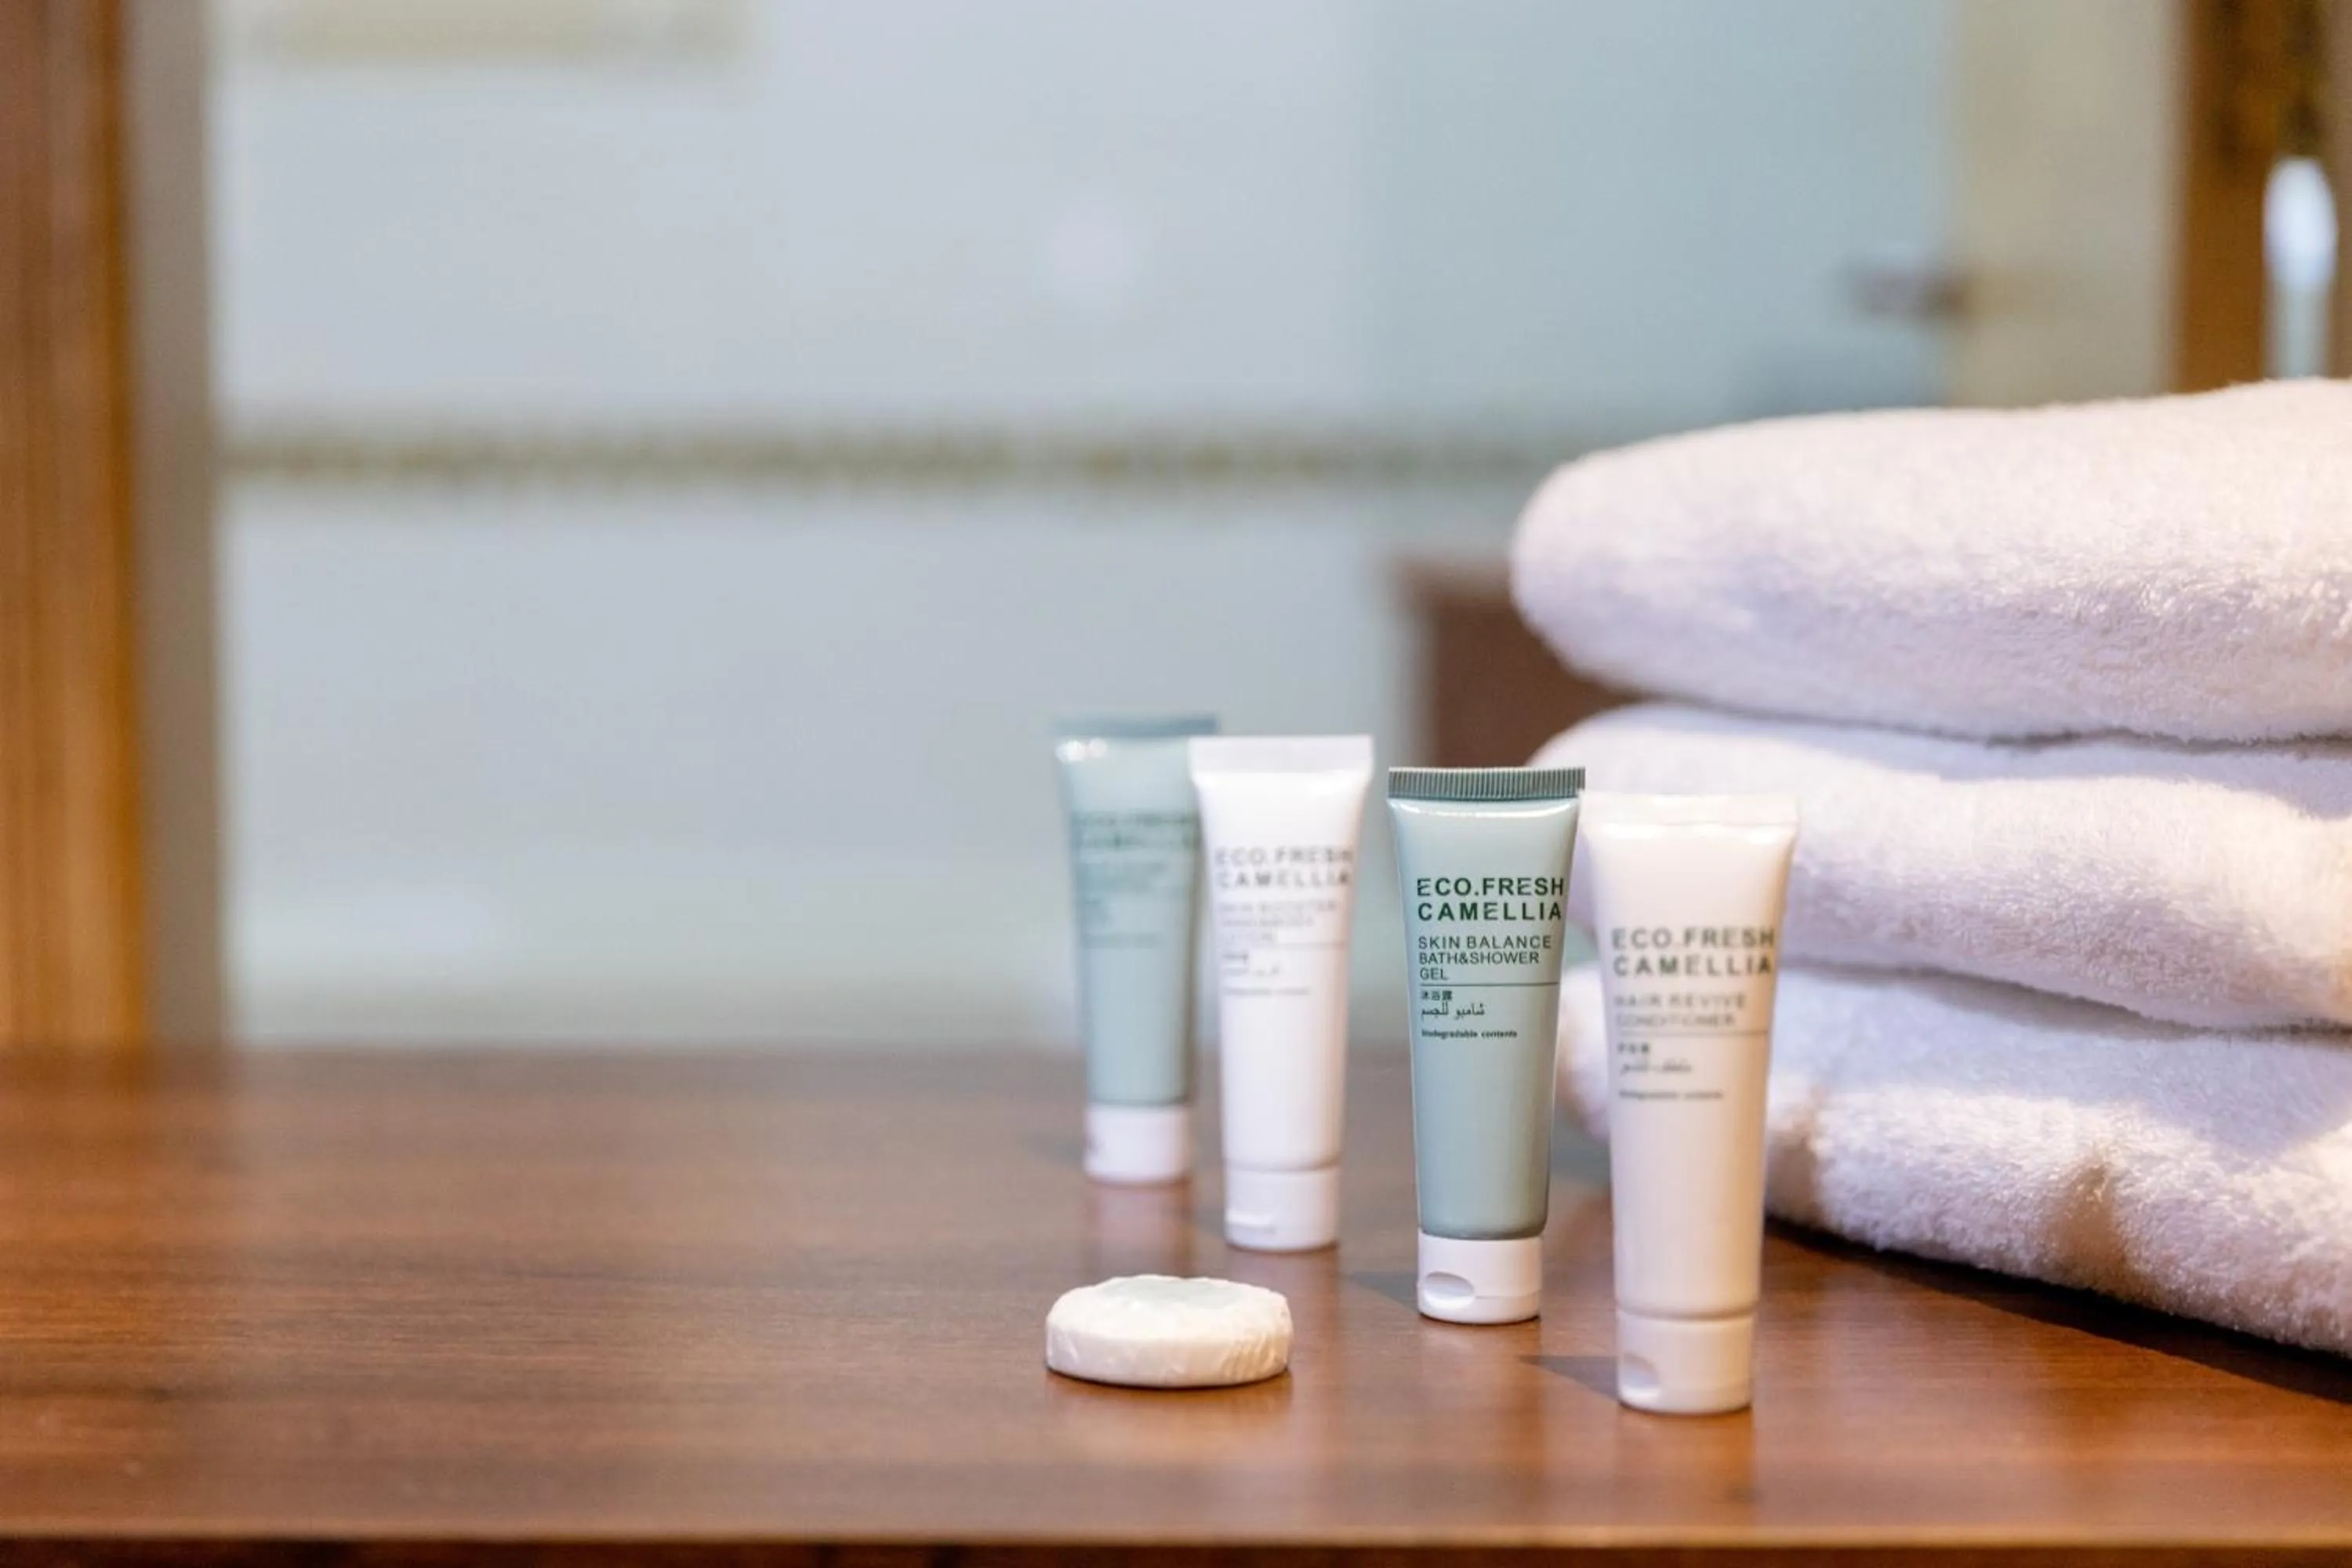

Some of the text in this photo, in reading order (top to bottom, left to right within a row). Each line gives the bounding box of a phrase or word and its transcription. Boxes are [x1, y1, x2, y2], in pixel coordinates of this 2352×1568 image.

[1218, 870, 1351, 889] CAMELLIA
[1417, 877, 1564, 896] ECO.FRESH
[1417, 902, 1562, 921] CAMELLIA
[1418, 935, 1552, 949] SKIN BALANCE
[1419, 951, 1539, 965] BATH&SHOWER
[1613, 954, 1773, 976] CAMELLIA
[1420, 967, 1448, 980] GEL
[1481, 1029, 1518, 1039] contents
